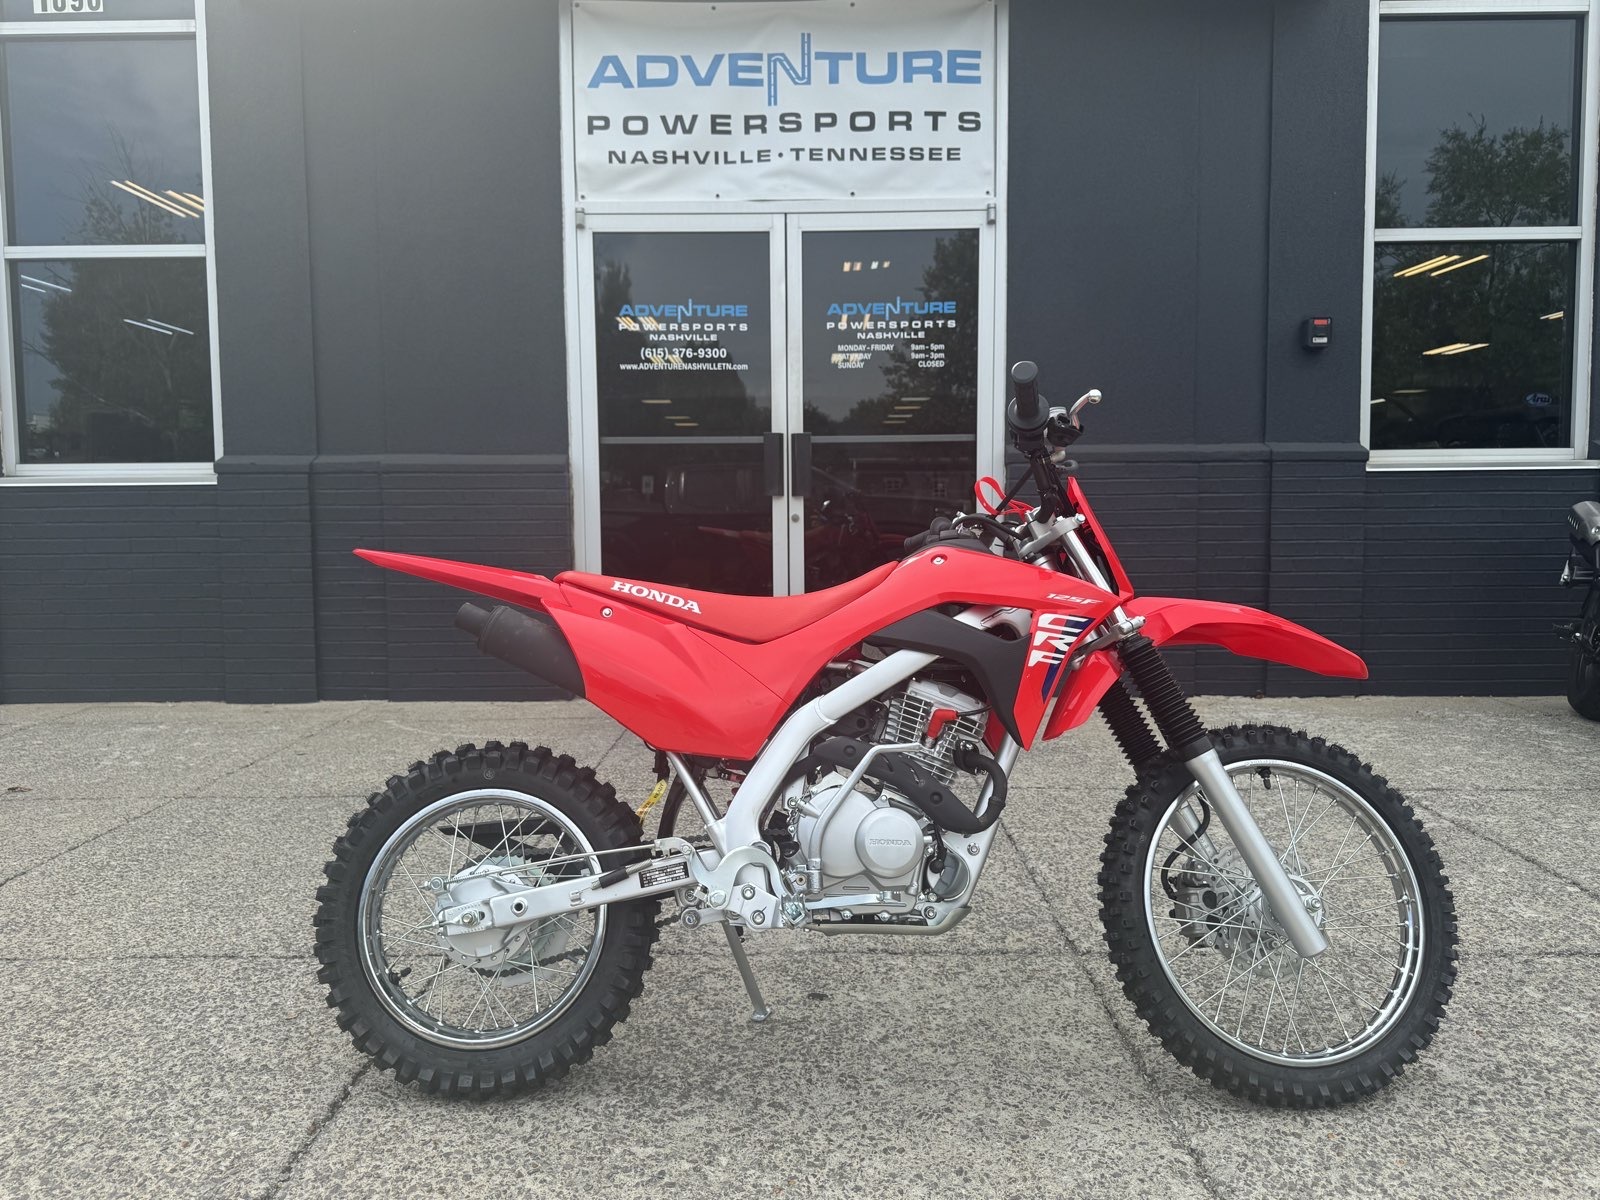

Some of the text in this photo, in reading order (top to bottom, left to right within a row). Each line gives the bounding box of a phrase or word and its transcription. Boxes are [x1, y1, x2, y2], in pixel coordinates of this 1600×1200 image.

[587, 33, 982, 106] ADVENTURE
[587, 111, 982, 136] POWERSPORTS
[608, 147, 961, 165] NASHVILLE TENNESSEE
[619, 299, 748, 322] ADVENTURE
[827, 296, 956, 320] ADVENTURE
[618, 323, 748, 332] POWERSPORTS
[826, 320, 956, 330] POWERSPORTS
[857, 331, 925, 340] NASHVILLE
[640, 347, 727, 359] (615) 376-9300
[620, 362, 749, 371] www.ADVENTURENASHVILLETN.com
[837, 361, 865, 369] SUNDAY
[918, 360, 945, 368] CLOSED
[610, 581, 702, 614] HONDA
[1046, 593, 1103, 604] 125F
[1028, 613, 1089, 667] CRF
[869, 838, 912, 846] HONDA
